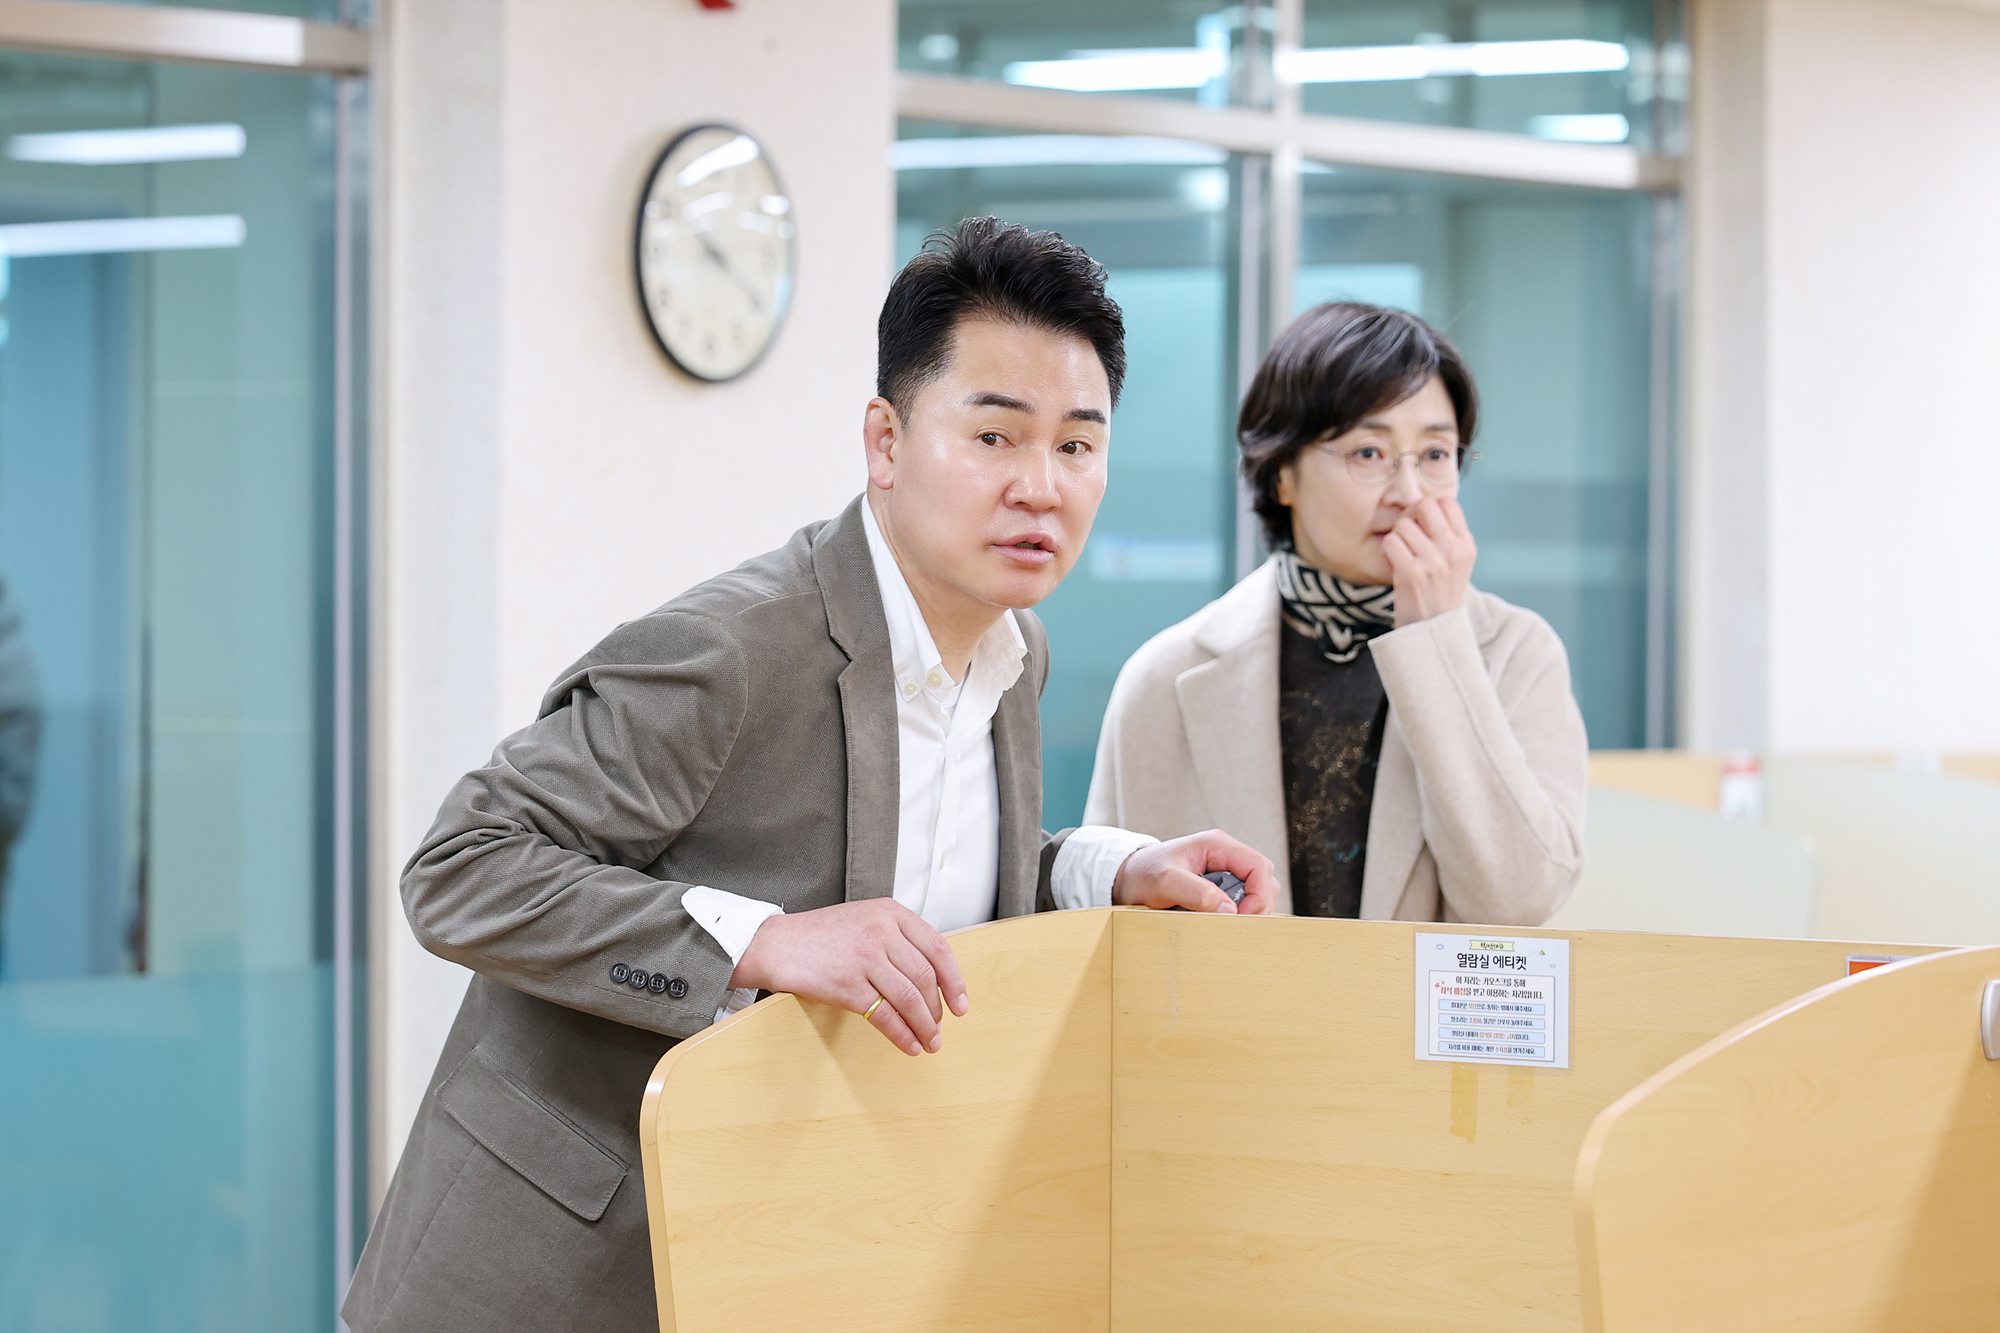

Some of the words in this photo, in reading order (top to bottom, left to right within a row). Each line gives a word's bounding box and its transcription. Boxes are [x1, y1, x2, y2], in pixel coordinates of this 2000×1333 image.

[1457, 953, 1489, 969] 열람실
[1493, 955, 1527, 971] 에티켓
[1456, 976, 1462, 984] 이
[1464, 976, 1481, 985] 자리는
[1483, 977, 1511, 987] 키오스크를
[1514, 979, 1525, 988] 통해
[1441, 986, 1452, 995] 좌석
[1454, 987, 1471, 996] 배정을
[1473, 988, 1485, 997] 받고
[1487, 989, 1510, 998] 이용하는
[1512, 990, 1543, 1000] 자리입니다.
